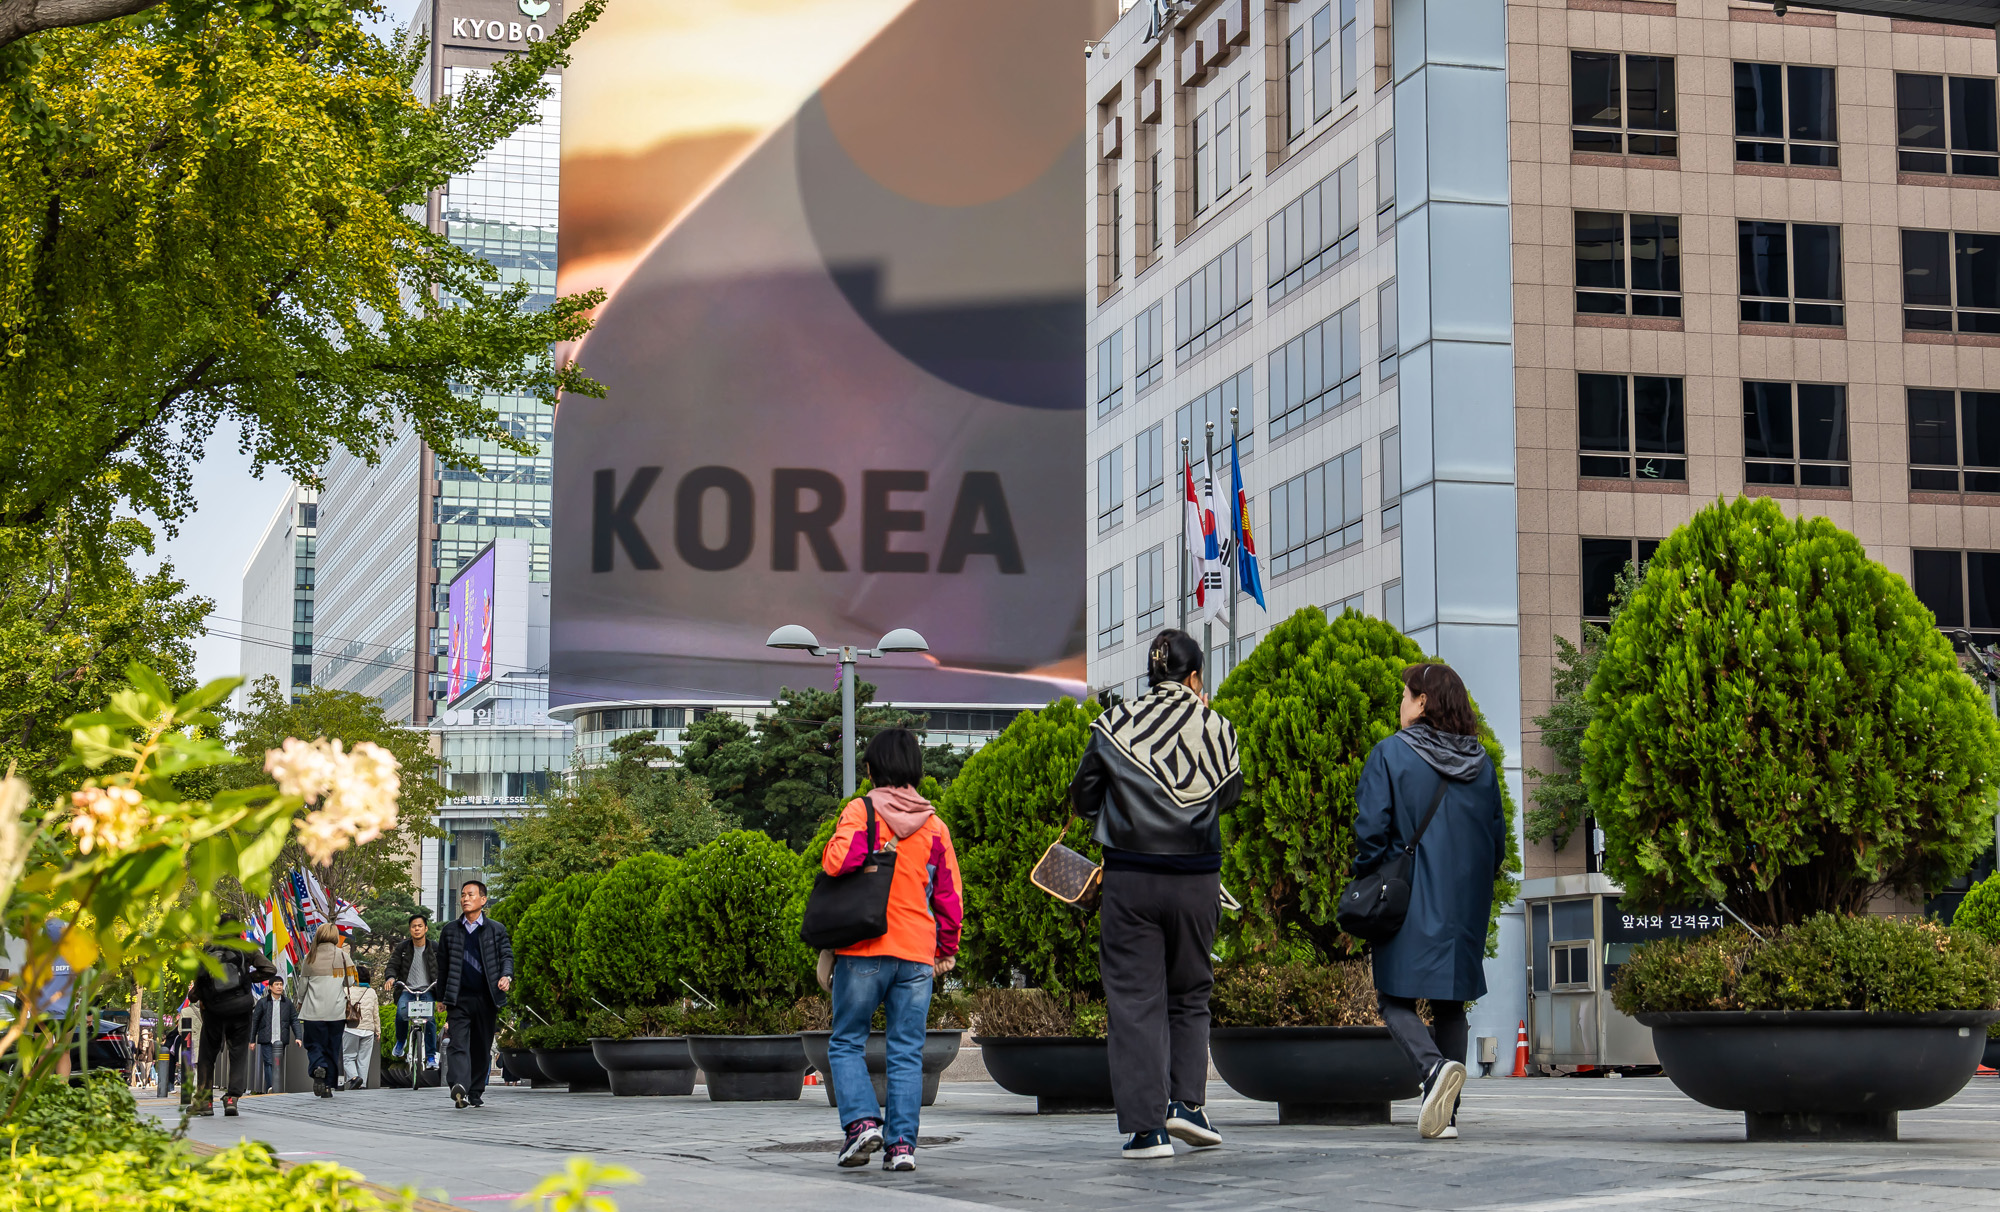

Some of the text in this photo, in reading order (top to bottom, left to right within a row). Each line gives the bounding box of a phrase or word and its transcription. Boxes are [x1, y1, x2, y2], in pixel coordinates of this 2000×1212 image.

[452, 17, 544, 43] KYOBO
[591, 465, 1026, 575] KOREA
[476, 708, 567, 726] 일민미술
[1621, 914, 1724, 929] 앞차와 간격유지
